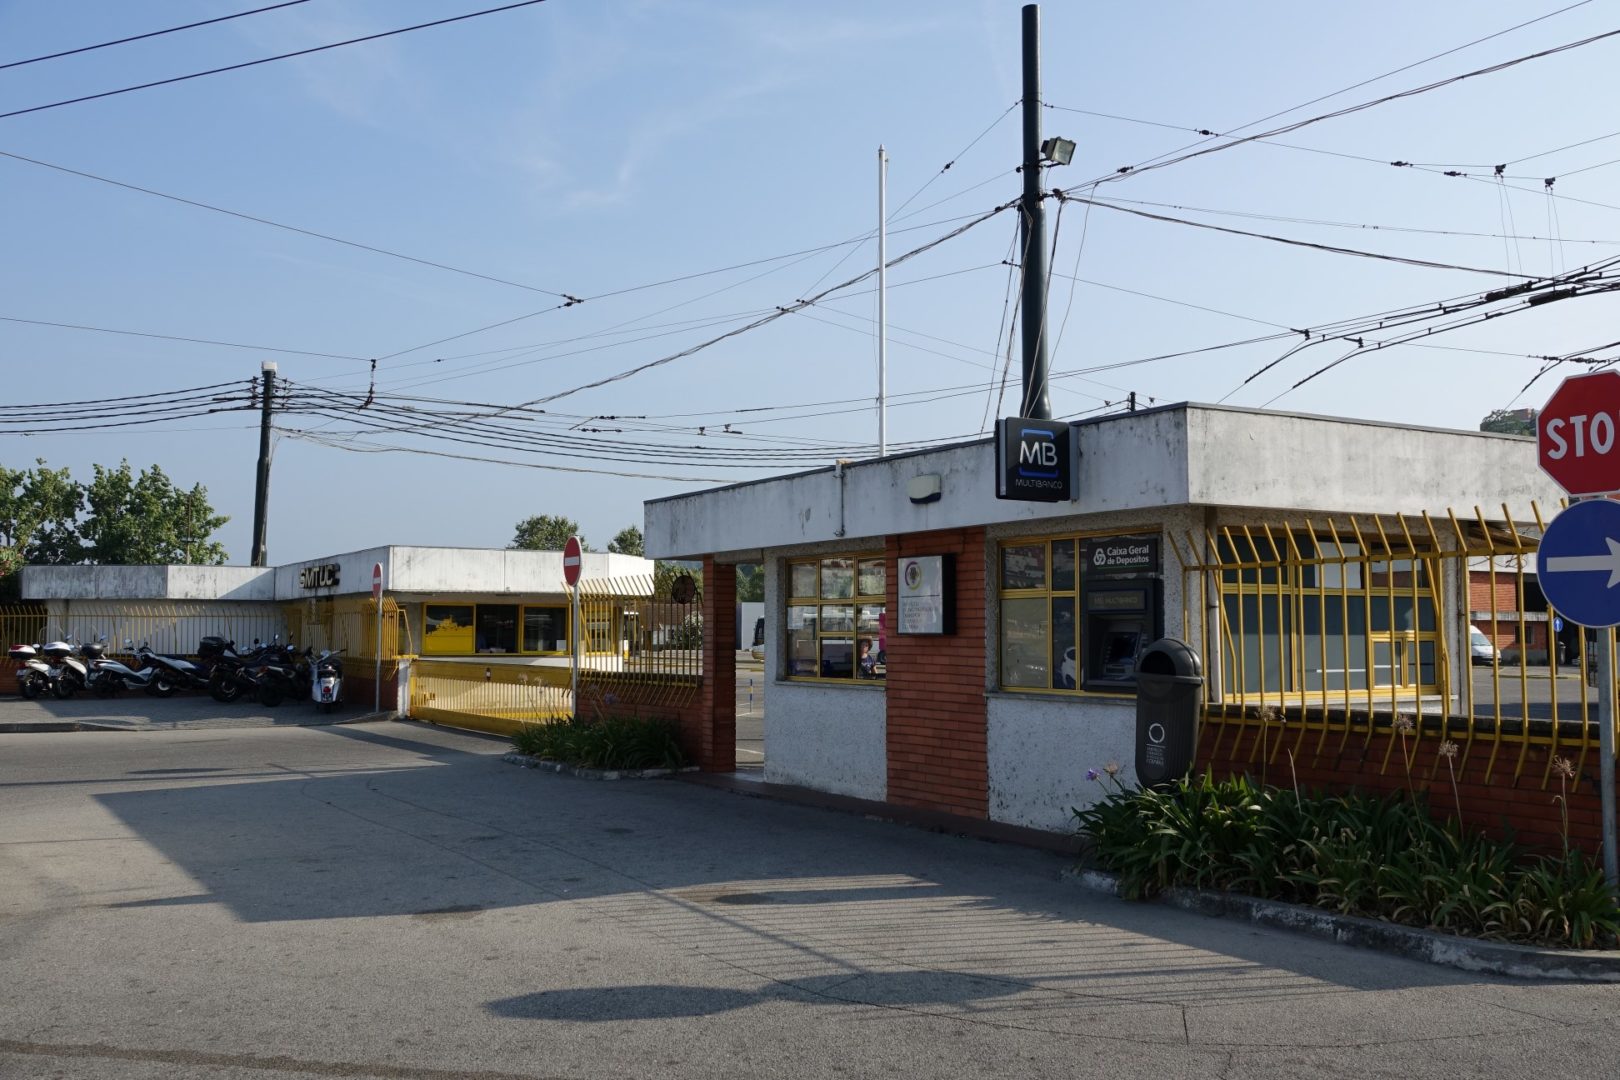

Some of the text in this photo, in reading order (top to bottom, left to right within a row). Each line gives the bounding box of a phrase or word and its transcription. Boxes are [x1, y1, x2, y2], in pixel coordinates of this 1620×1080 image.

[1546, 410, 1620, 460] STO
[1019, 440, 1058, 466] MB
[1015, 478, 1063, 489] MULTIBANCO
[1106, 544, 1149, 556] Caixa Geral
[1106, 556, 1115, 565] de
[299, 564, 338, 588] SMTUC
